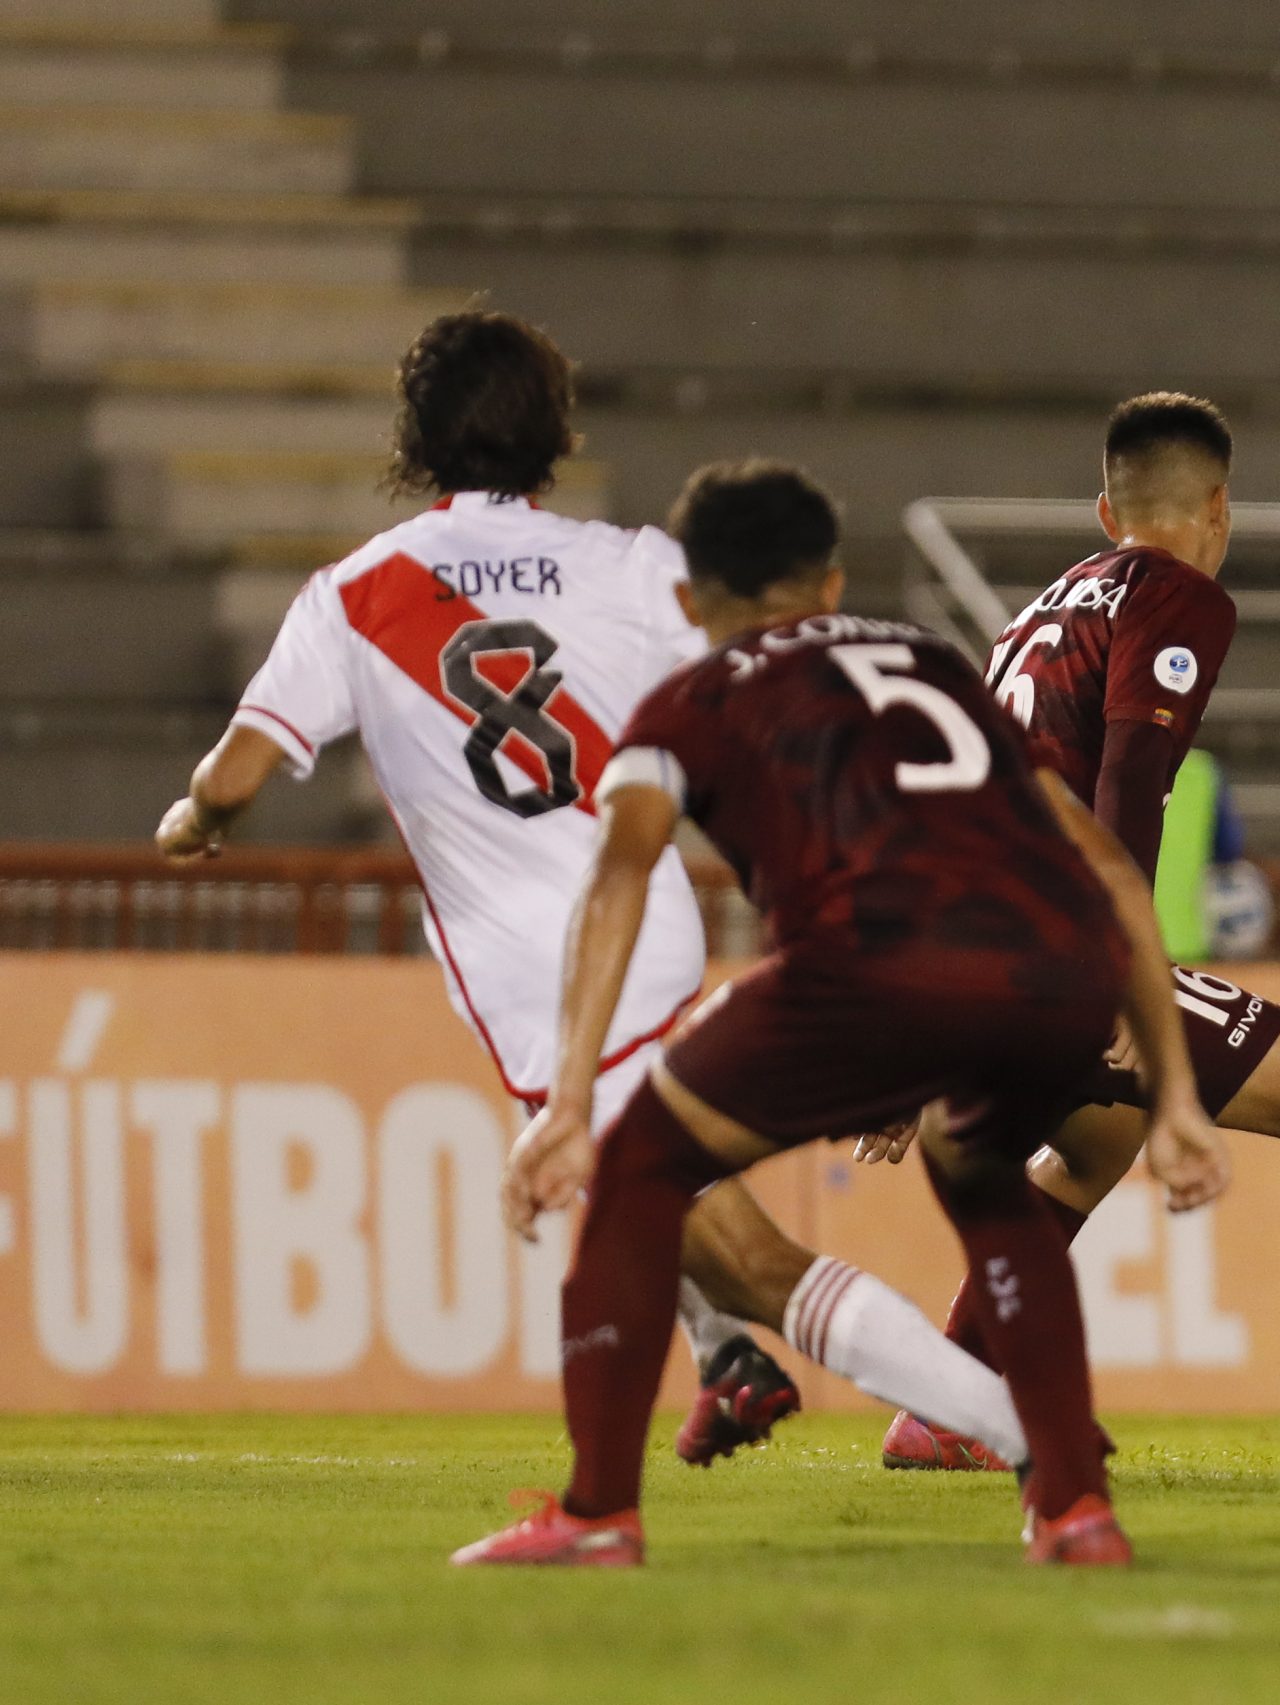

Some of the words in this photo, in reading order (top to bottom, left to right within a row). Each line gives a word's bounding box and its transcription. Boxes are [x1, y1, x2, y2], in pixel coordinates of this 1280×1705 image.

[432, 557, 562, 602] SOYER
[438, 617, 580, 820] 8
[827, 643, 992, 793] 5
[1172, 966, 1242, 1027] 16
